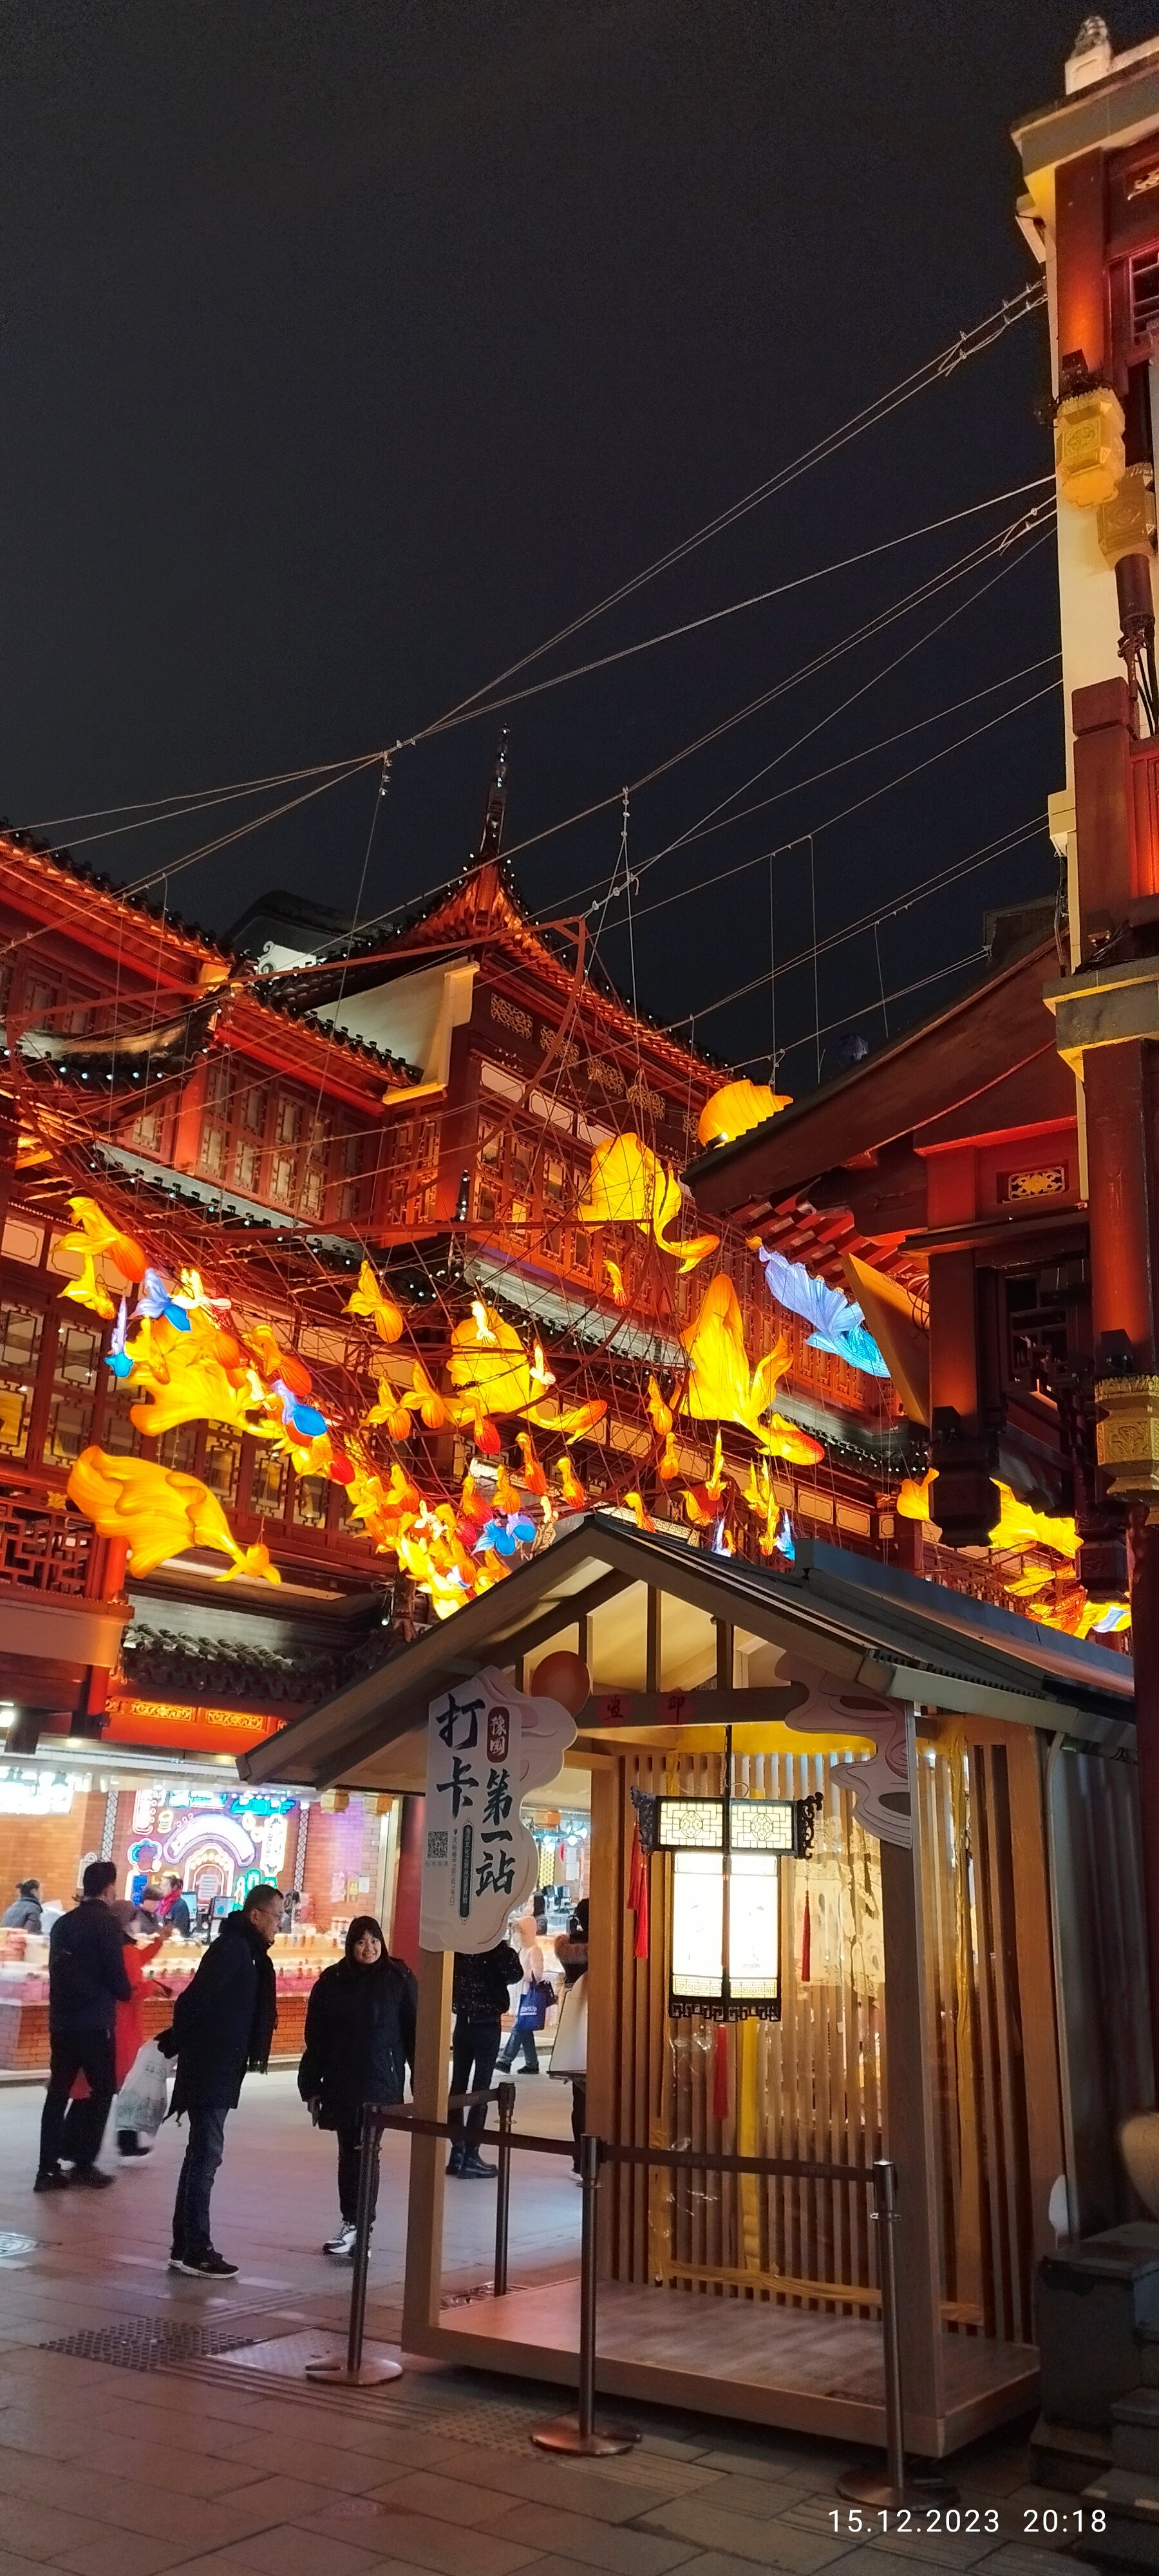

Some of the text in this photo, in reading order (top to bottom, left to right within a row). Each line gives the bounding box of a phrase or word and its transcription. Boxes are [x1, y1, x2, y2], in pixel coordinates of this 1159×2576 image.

[435, 1693, 486, 1820] 打卡
[476, 1768, 515, 1897] 第一站
